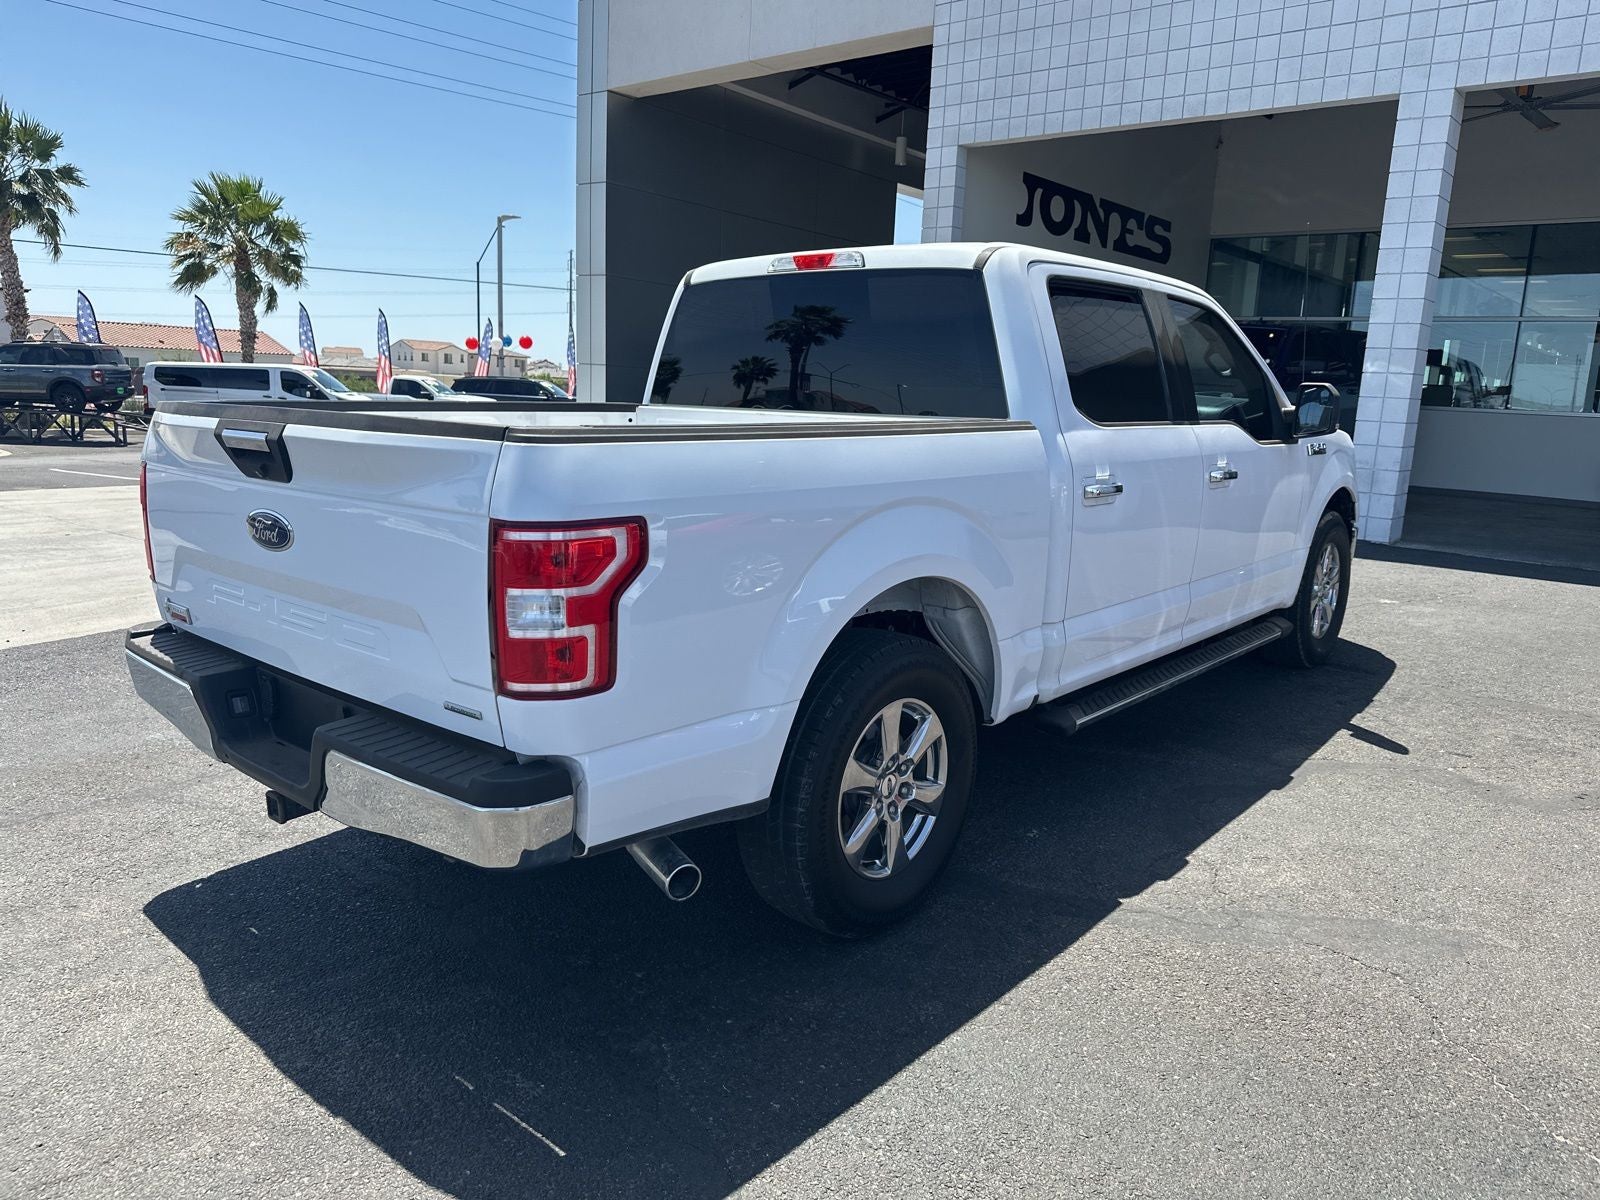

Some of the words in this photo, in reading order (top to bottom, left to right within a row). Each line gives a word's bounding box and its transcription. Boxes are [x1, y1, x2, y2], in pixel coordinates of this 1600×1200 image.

[1016, 171, 1172, 265] JONES
[253, 517, 279, 543] Ford
[206, 578, 391, 661] F-150
